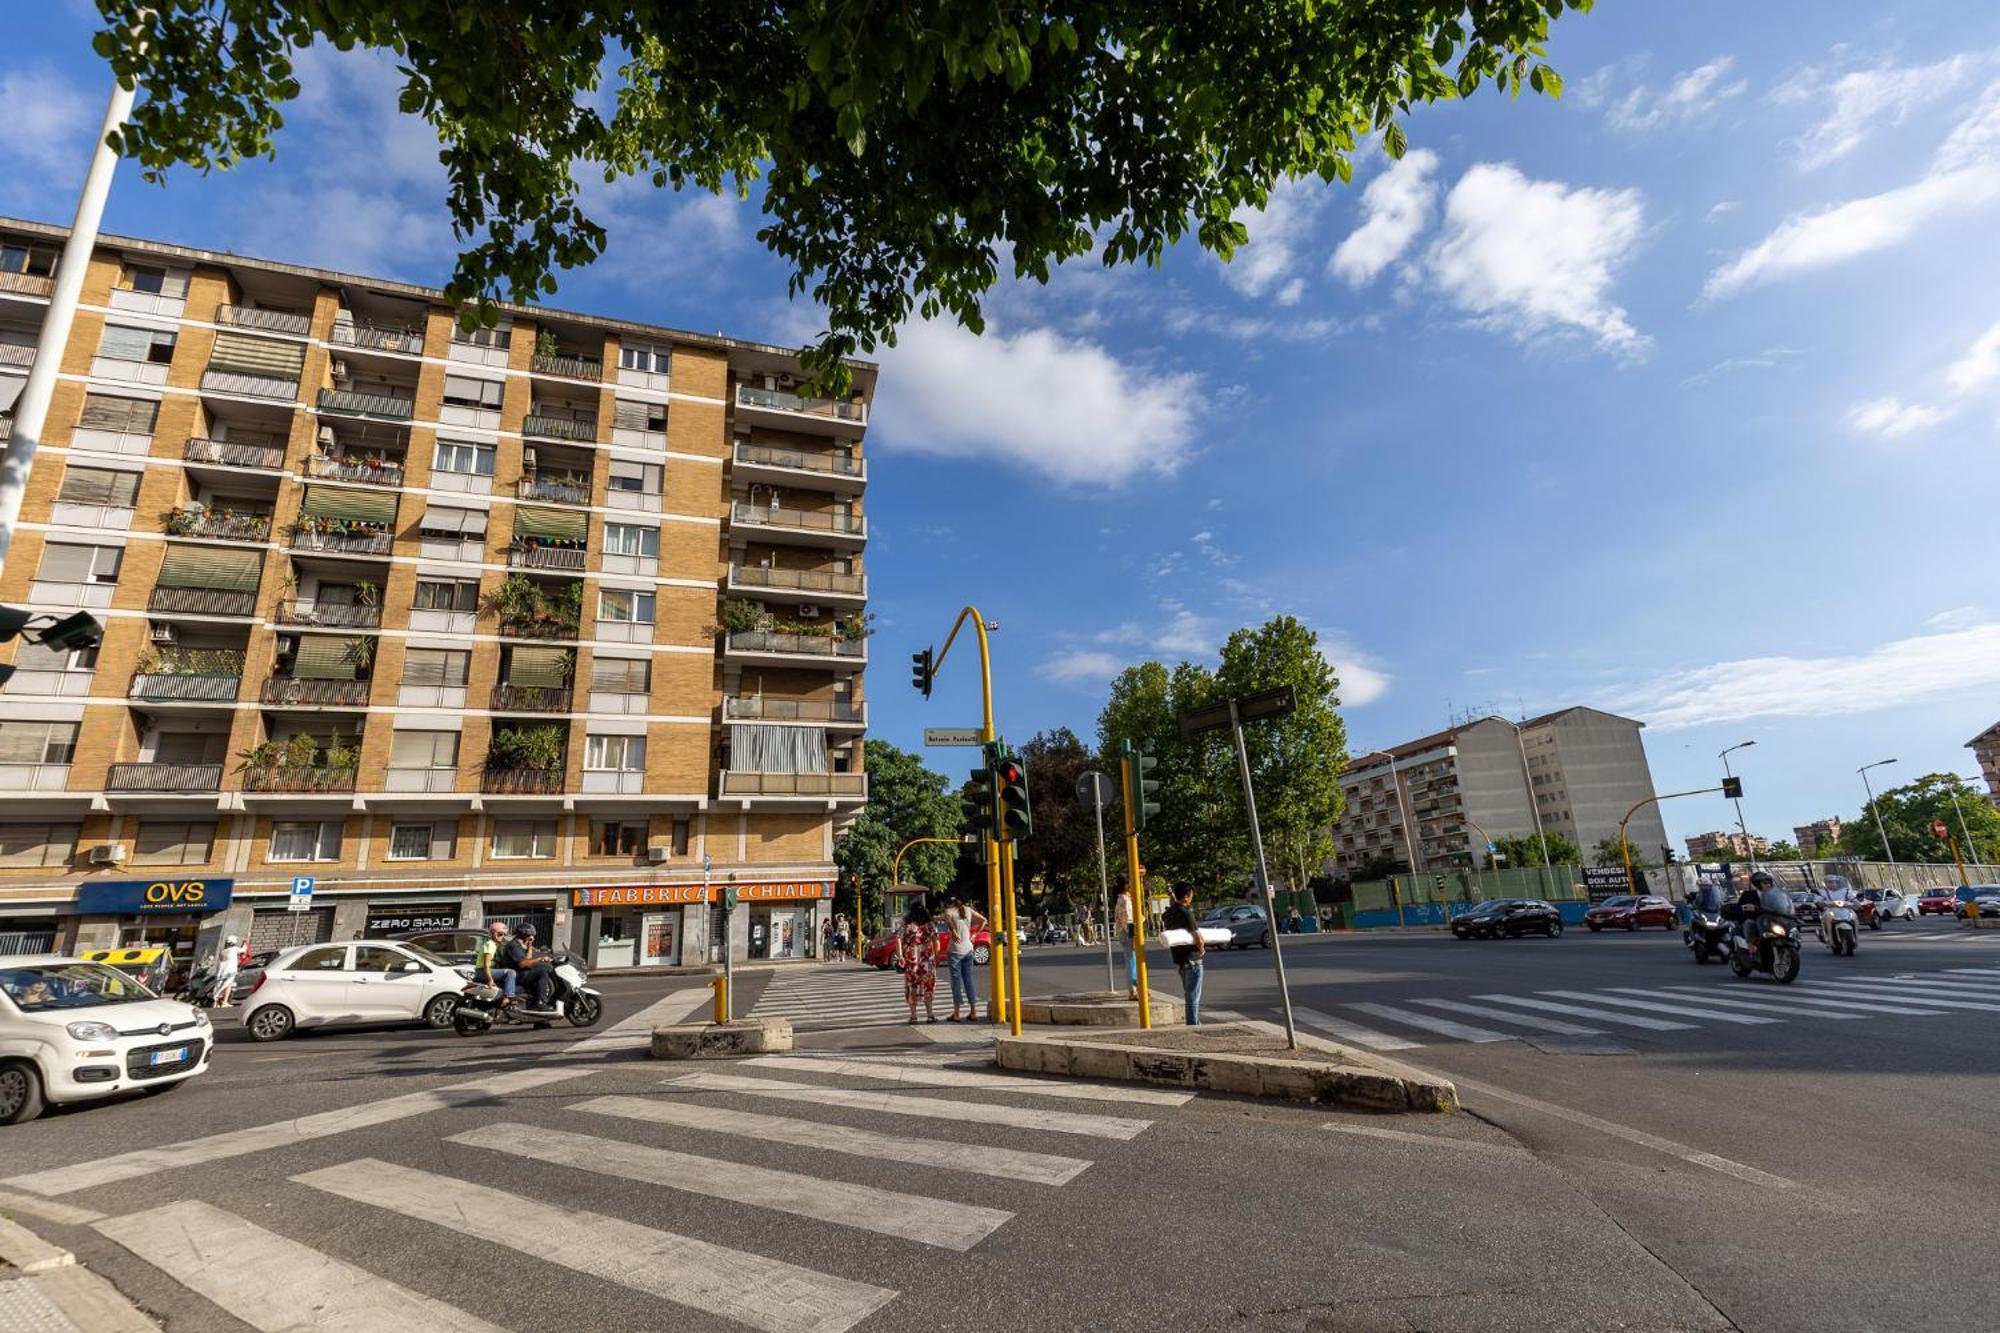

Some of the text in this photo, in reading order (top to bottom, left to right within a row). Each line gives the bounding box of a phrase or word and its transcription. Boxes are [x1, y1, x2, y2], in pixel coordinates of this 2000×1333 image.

[147, 882, 205, 902] OVS
[295, 879, 310, 893] P
[598, 884, 815, 902] FABBRICA CCHIALI
[370, 917, 454, 928] ZERO GRADI
